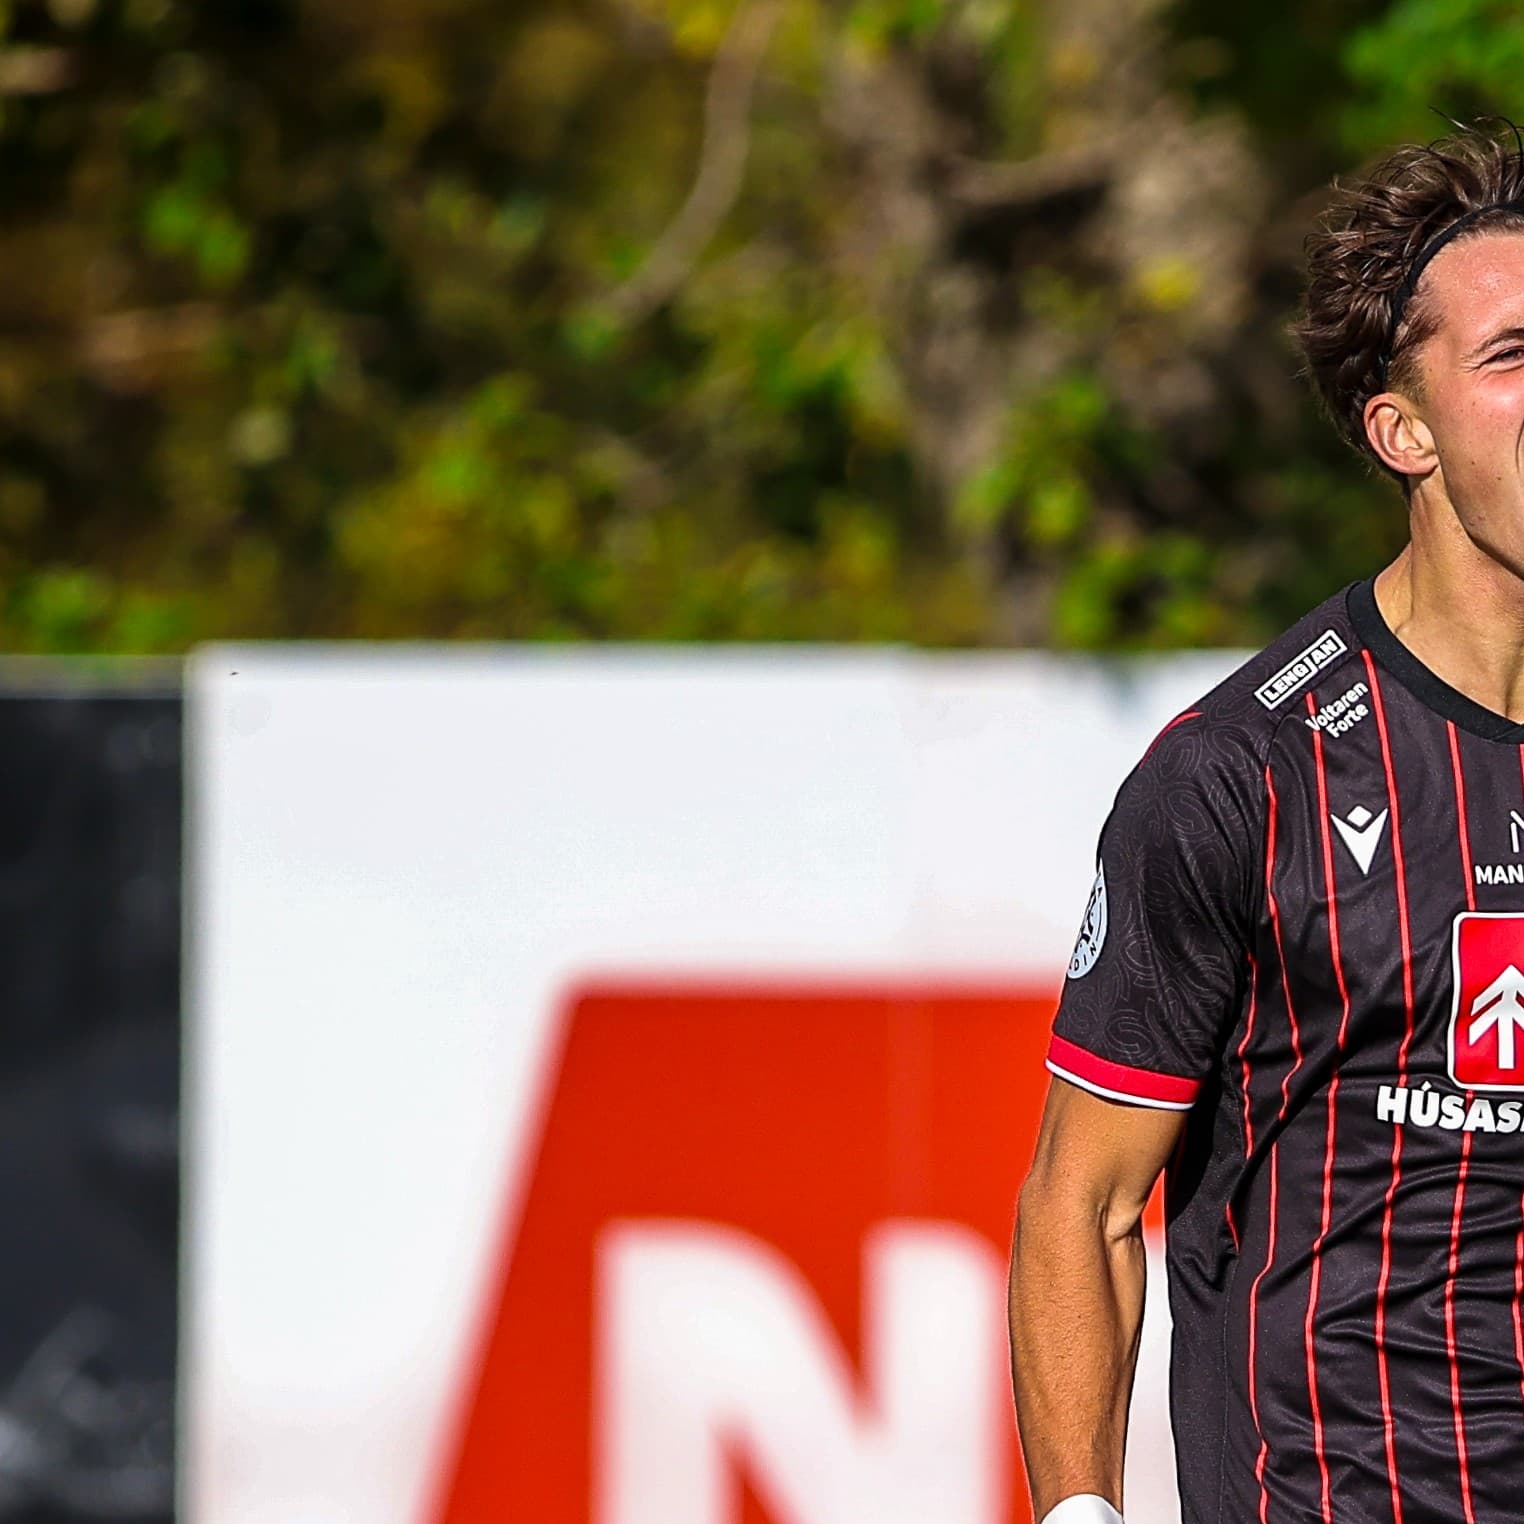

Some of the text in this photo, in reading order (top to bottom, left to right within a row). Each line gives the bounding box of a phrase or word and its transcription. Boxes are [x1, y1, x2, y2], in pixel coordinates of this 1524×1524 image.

[1263, 637, 1338, 701] LENGJAN
[1304, 681, 1369, 732] Voltaren
[1326, 702, 1369, 738] Forte
